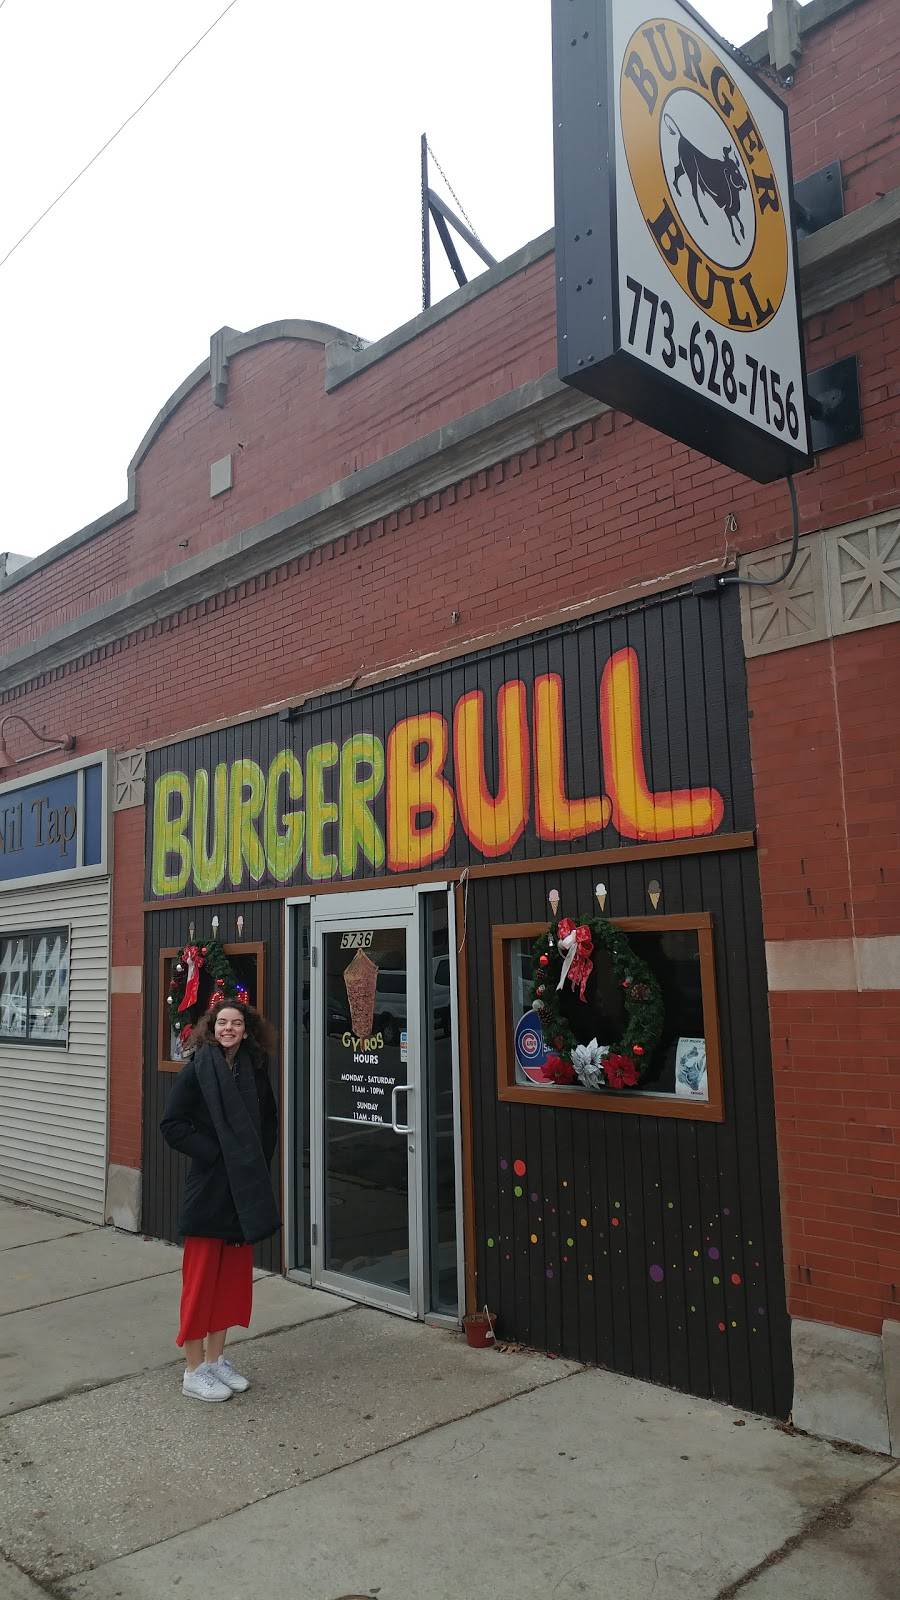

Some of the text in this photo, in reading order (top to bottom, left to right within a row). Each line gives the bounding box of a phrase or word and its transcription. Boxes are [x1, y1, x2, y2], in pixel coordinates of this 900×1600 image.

[624, 24, 779, 215] BURGER
[646, 198, 774, 329] BULL
[626, 275, 799, 440] 773-628-7156
[152, 646, 724, 896] BURGER BULL
[31, 796, 77, 857] Tap
[342, 932, 372, 947] 5736
[353, 1053, 379, 1065] HOURS
[341, 1074, 364, 1082] MONDAY
[367, 1076, 396, 1085] SATURDAY
[351, 1085, 366, 1093] 11AM
[370, 1086, 384, 1095] 10PM
[356, 1101, 379, 1111] SUNDAY
[352, 1112, 368, 1120] 11AM
